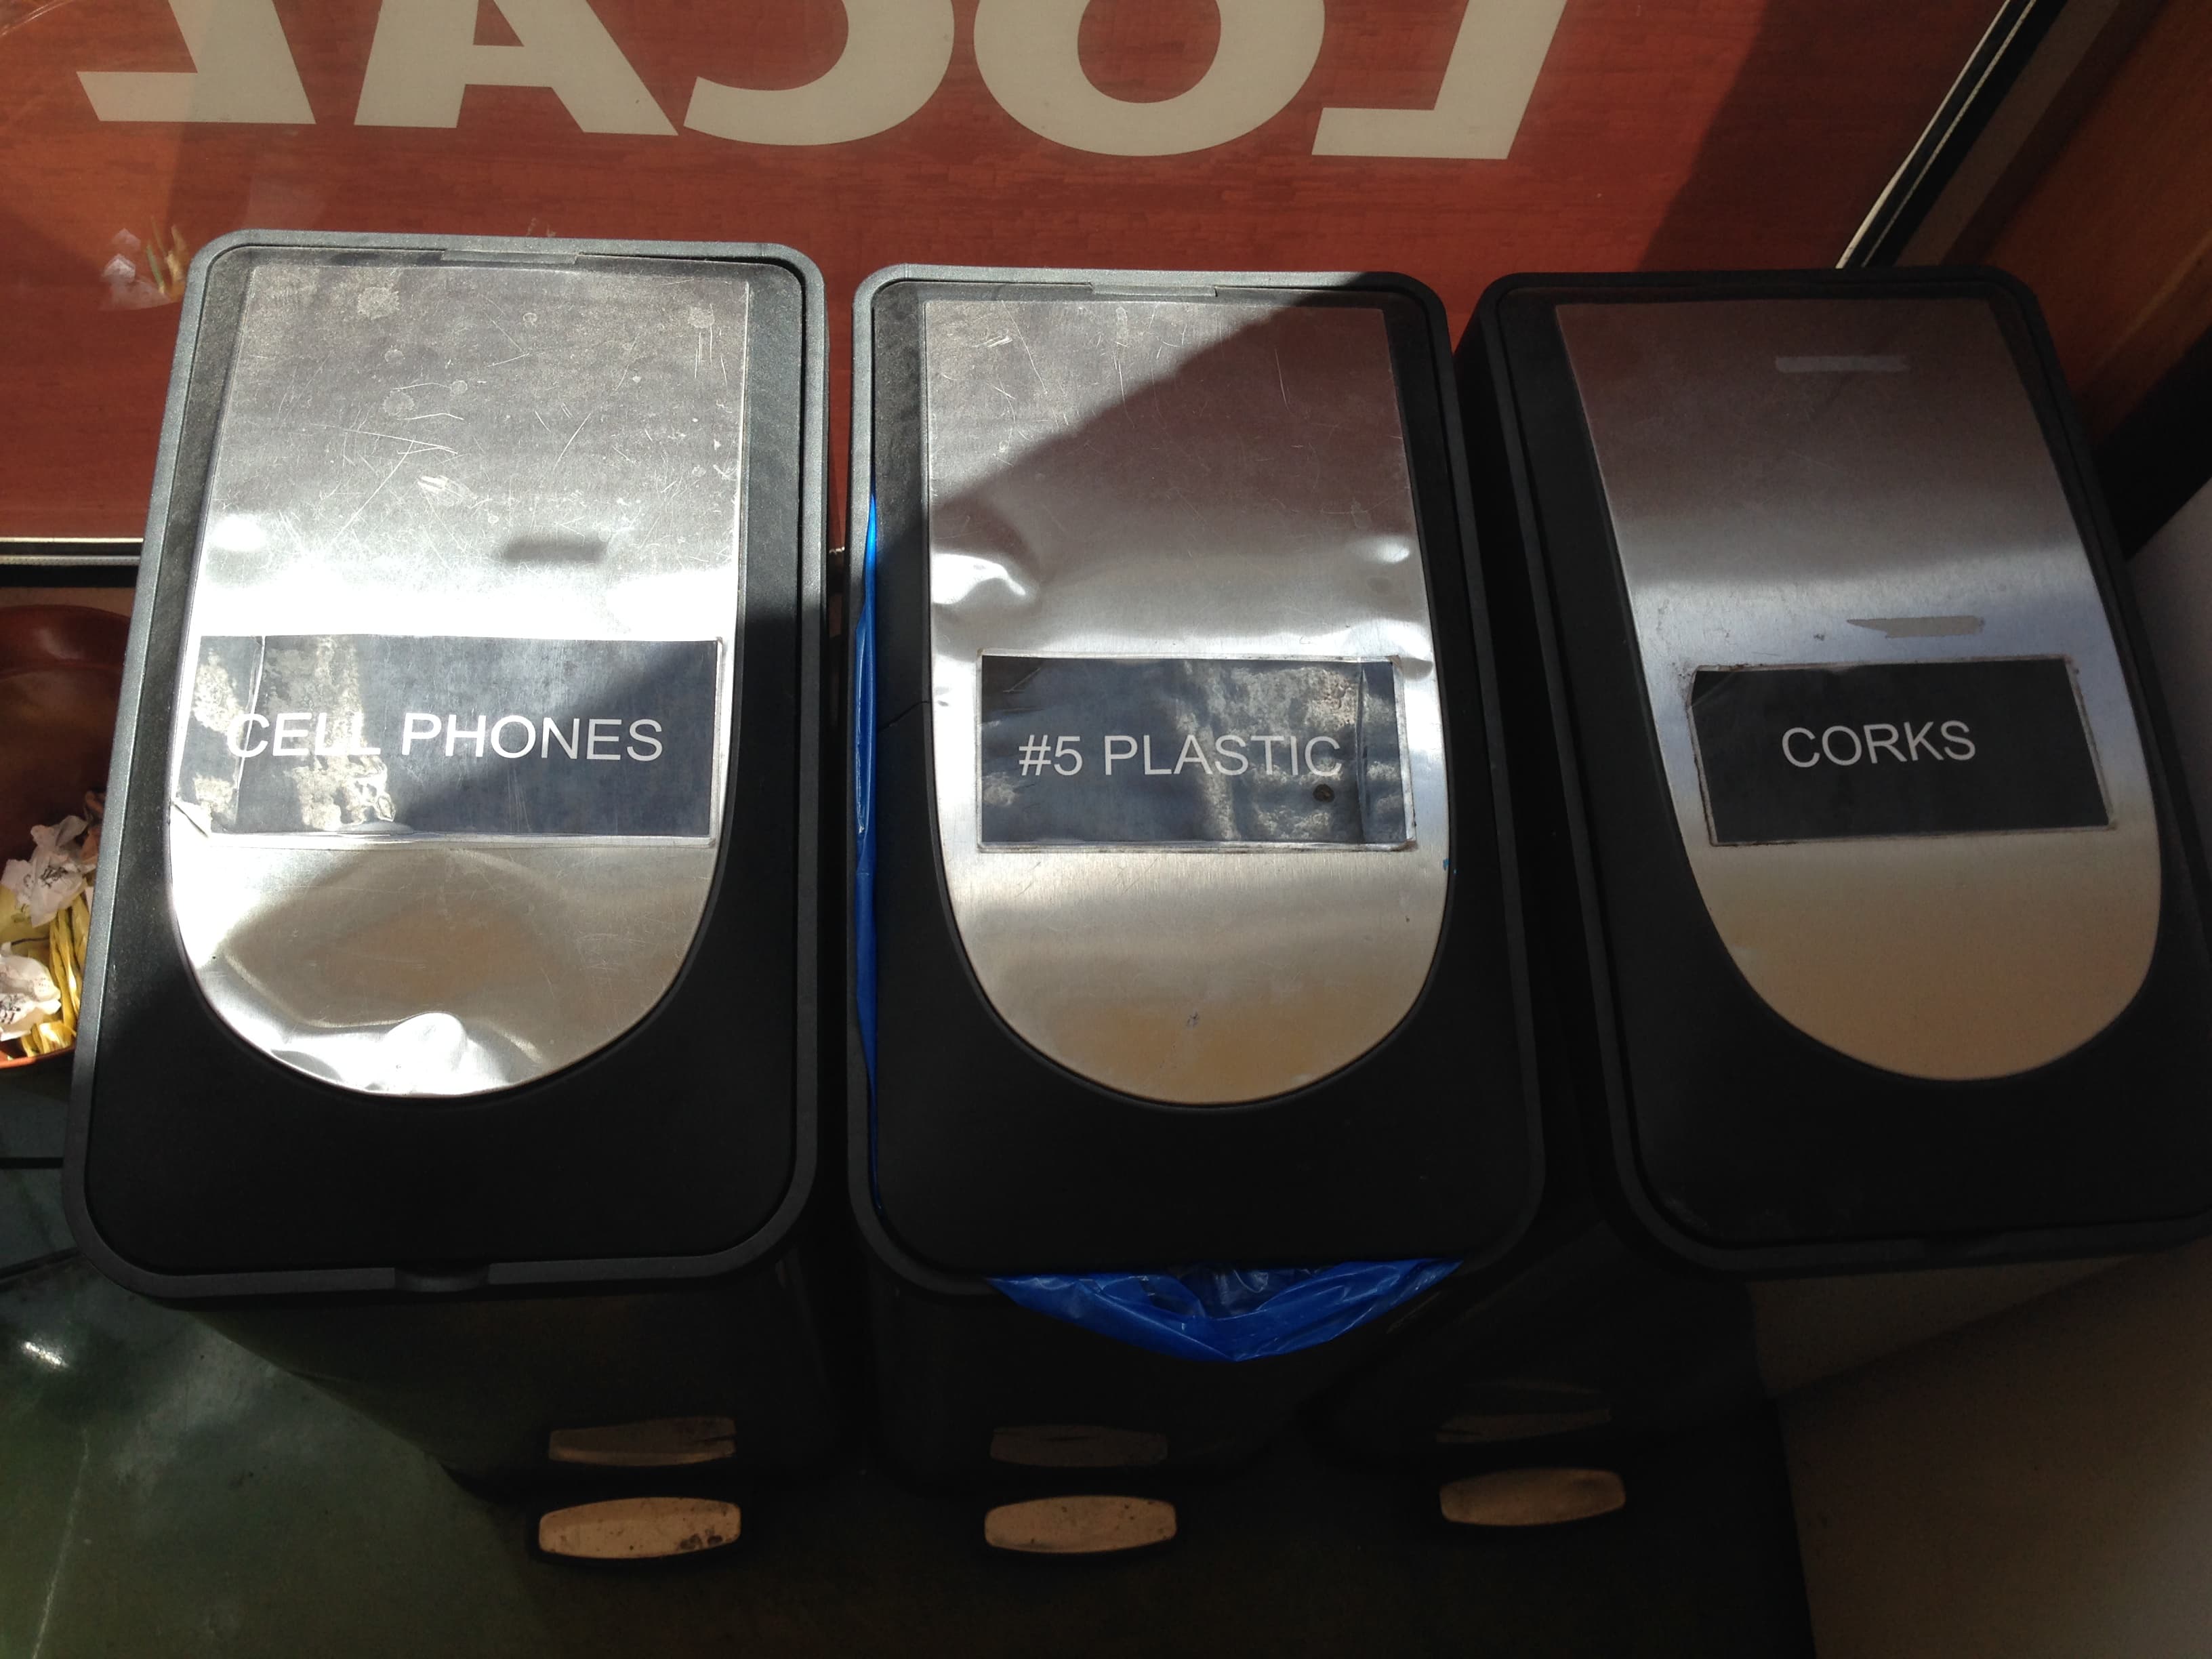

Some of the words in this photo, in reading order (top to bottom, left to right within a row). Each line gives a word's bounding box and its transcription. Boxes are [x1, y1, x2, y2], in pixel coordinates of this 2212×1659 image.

[226, 712, 382, 758] CELL
[401, 712, 664, 762] PHONES
[1019, 735, 1083, 776] #5
[1103, 735, 1343, 777] PLASTIC
[1782, 720, 1975, 767] CORKS
